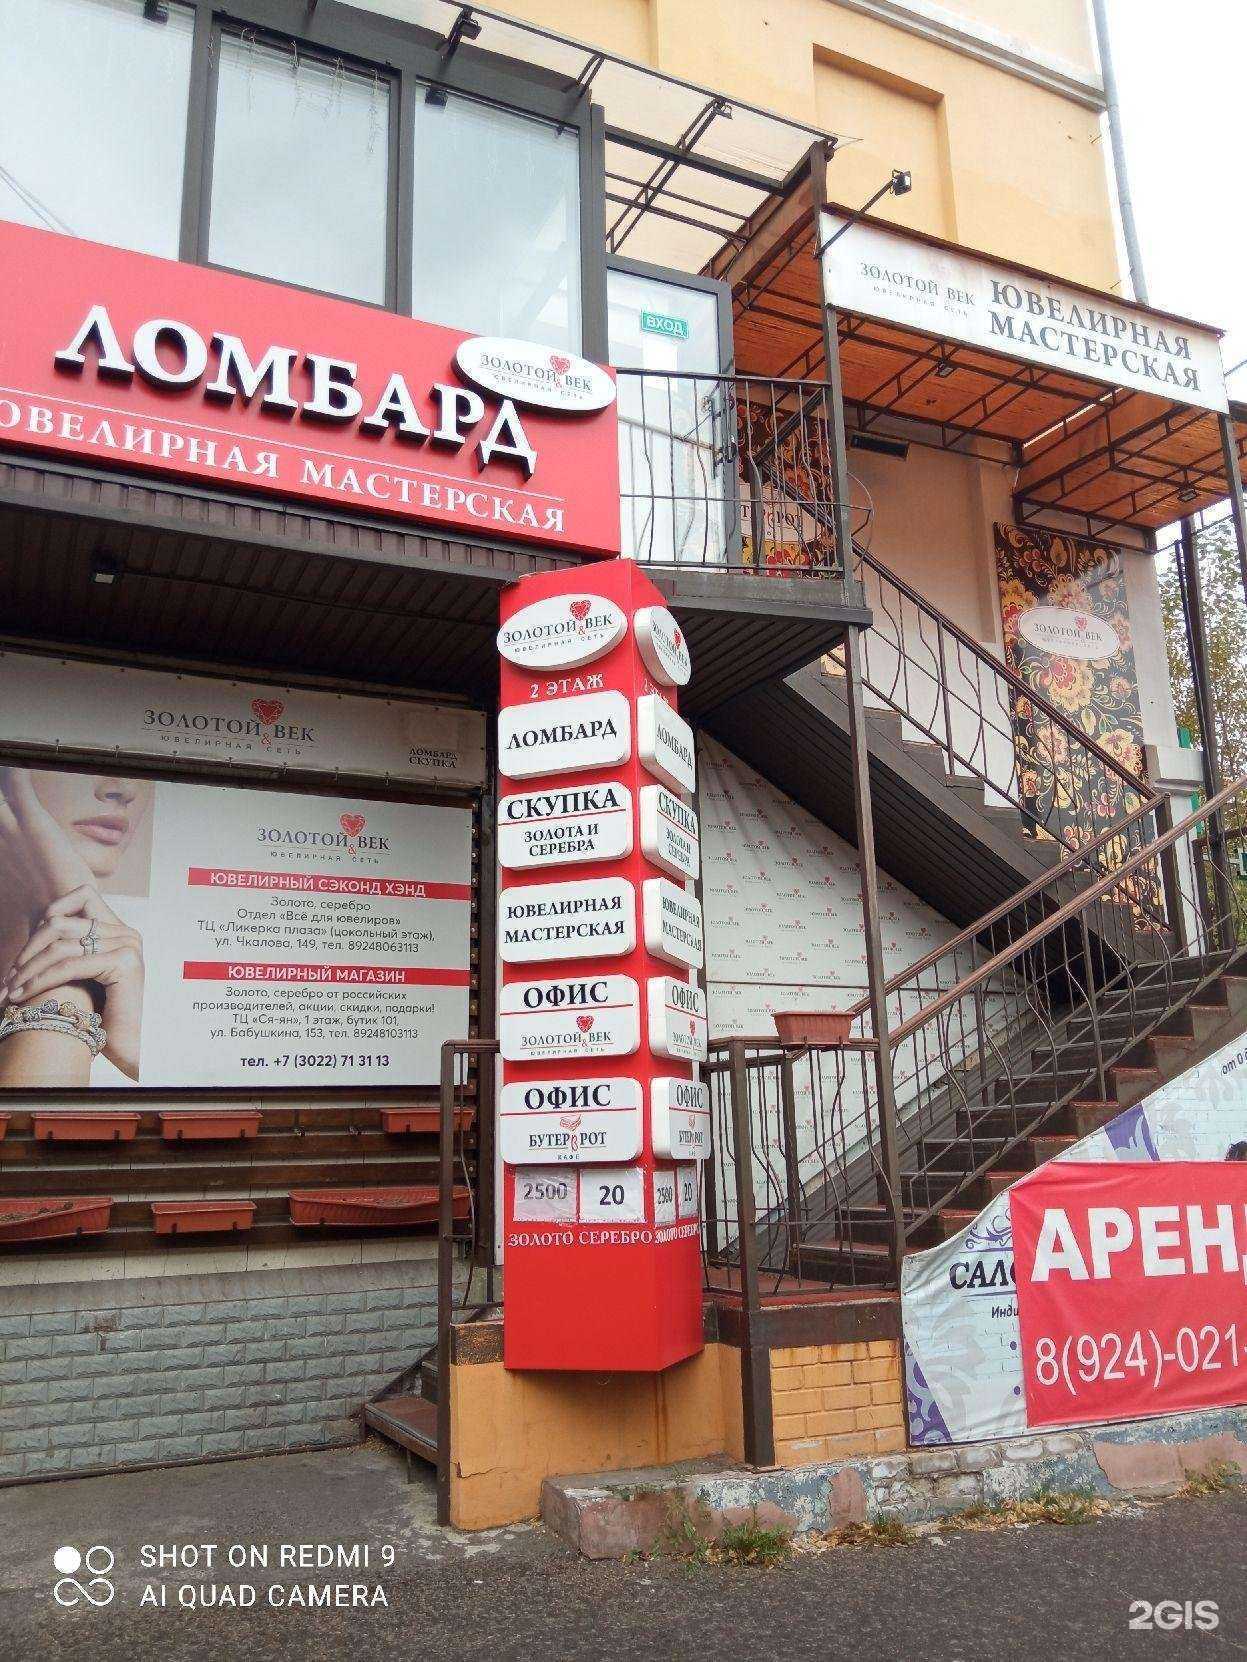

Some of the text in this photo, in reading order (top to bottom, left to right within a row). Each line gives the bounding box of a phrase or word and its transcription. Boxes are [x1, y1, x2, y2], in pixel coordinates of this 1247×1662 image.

[860, 262, 975, 306] ЗОЛОТОЙ ВЕК
[647, 316, 684, 337] ВХОД
[989, 279, 1192, 360] ЮВЕЛИРНАЯ
[987, 310, 1201, 392] МАСТЕРСКАЯ
[481, 353, 592, 391] ЗОЛОТОЙ ВЕК
[56, 304, 538, 478] ЛОМБАРД
[301, 459, 565, 534] МАСТЕРСКАЯ
[503, 619, 576, 644] ЗОЛОТОЙ
[585, 613, 612, 629] ВЕК
[529, 673, 604, 698] 2 ЭТАЖ
[143, 709, 261, 736] ЗОЛОТОЙ
[274, 725, 315, 742] ВЕК
[505, 719, 618, 750] ЛОМБАРД
[160, 735, 252, 751] ЮВЕЛИРНАЯ
[657, 723, 693, 770] ЛОМБАРД
[409, 757, 457, 769] СКУПКА
[507, 788, 620, 821] СКУПКА
[658, 791, 696, 835] СКУПКА
[257, 828, 348, 847] ЗОЛОТОЙ
[358, 836, 391, 851] ВЕК
[524, 823, 599, 843] ЗОЛОТА И
[529, 839, 595, 857] СЕРЕБРА
[210, 871, 426, 898] ЮВЕЛИРНЫЙ СЭКОНД ХЭНД
[270, 896, 372, 911] Золото, серебро
[507, 896, 622, 920] ЮВЕЛИРНАЯ
[237, 908, 276, 922] Отдел
[310, 912, 333, 924] для
[336, 914, 401, 927] ювелиров»
[197, 920, 436, 943] ТЦ «Ликерка плаза» (цокольный этаж),
[504, 920, 625, 944] МАСТЕРСКАЯ
[214, 936, 420, 953] ул. Чкалова, 149, тел. 89248063113
[227, 965, 406, 983] ЮВЕЛИРНЫЙ МАГАЗИН
[225, 987, 407, 1003] Золото, серебро от российских
[523, 981, 609, 1009] ОФИС
[672, 985, 700, 1013] ОФИС
[192, 1001, 436, 1016] производителей, акции, скидки, подарки!
[232, 1014, 400, 1028] ТЦ «Ся-ян», 1 этаж, бутик 101,
[210, 1027, 419, 1041] ул. Бабушкина, 153, тел. 89248103113
[521, 1031, 581, 1047] ЗОЛОТОЙ
[588, 1031, 612, 1043] ВЕК
[240, 1054, 389, 1069] тел. +7 (3022) 71 31 13
[524, 1084, 611, 1110] ОФИС
[676, 1084, 703, 1109] ОФИС
[523, 1181, 625, 1206] 2500 20
[656, 1182, 693, 1205] 2500 20
[507, 1228, 653, 1247] ЗОЛОТО СЕРЕБРО
[655, 1226, 678, 1244] ЗОЛОТО
[1030, 1203, 1247, 1287] АРЕН
[1036, 1322, 1247, 1397] 8(924)-021
